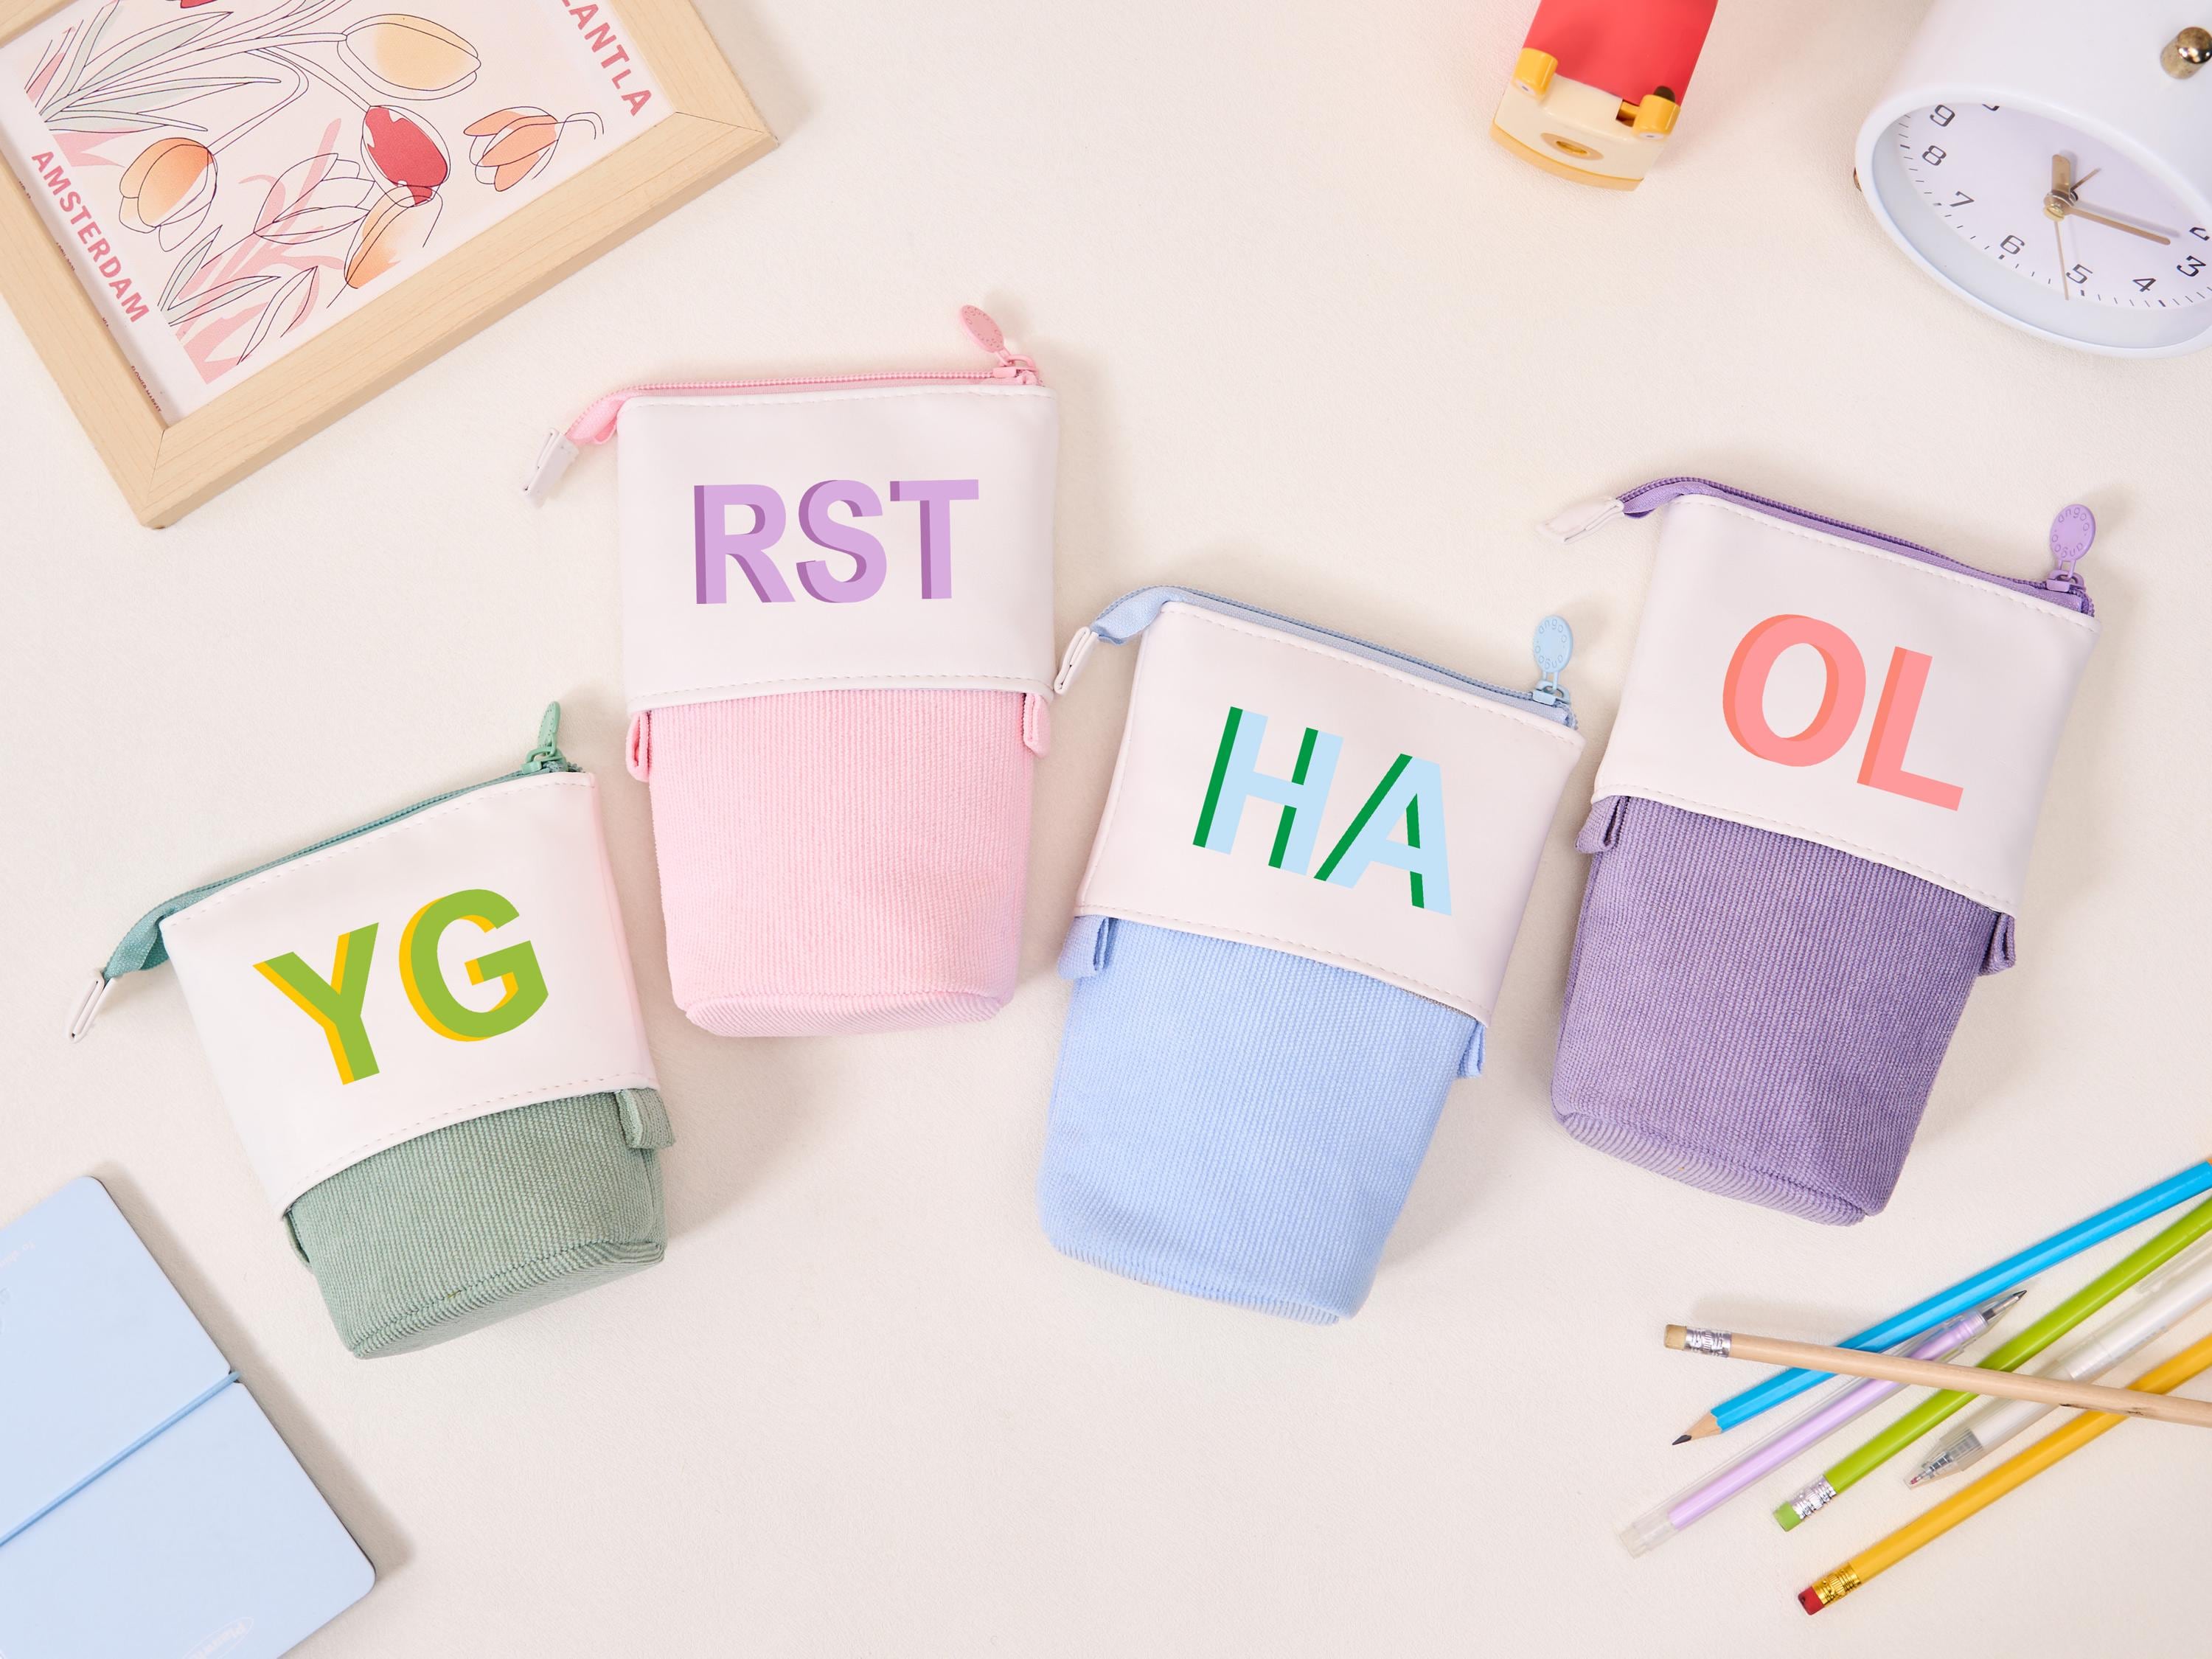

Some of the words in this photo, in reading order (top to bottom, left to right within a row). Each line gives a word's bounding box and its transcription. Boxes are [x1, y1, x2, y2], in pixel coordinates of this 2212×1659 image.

[562, 0, 652, 116] ANTLA
[1930, 104, 1955, 127] 9
[1921, 145, 1947, 166] 8
[1950, 191, 1975, 206] 7
[31, 151, 150, 322] AMSTERDAM
[2000, 234, 2025, 254] 6
[2065, 264, 2093, 284] 5
[2176, 255, 2207, 276] 3
[2132, 276, 2157, 292] 4
[694, 479, 979, 604] RST
[1722, 614, 1964, 811] OL
[1192, 706, 1452, 916] HA
[252, 888, 549, 1085] YG
